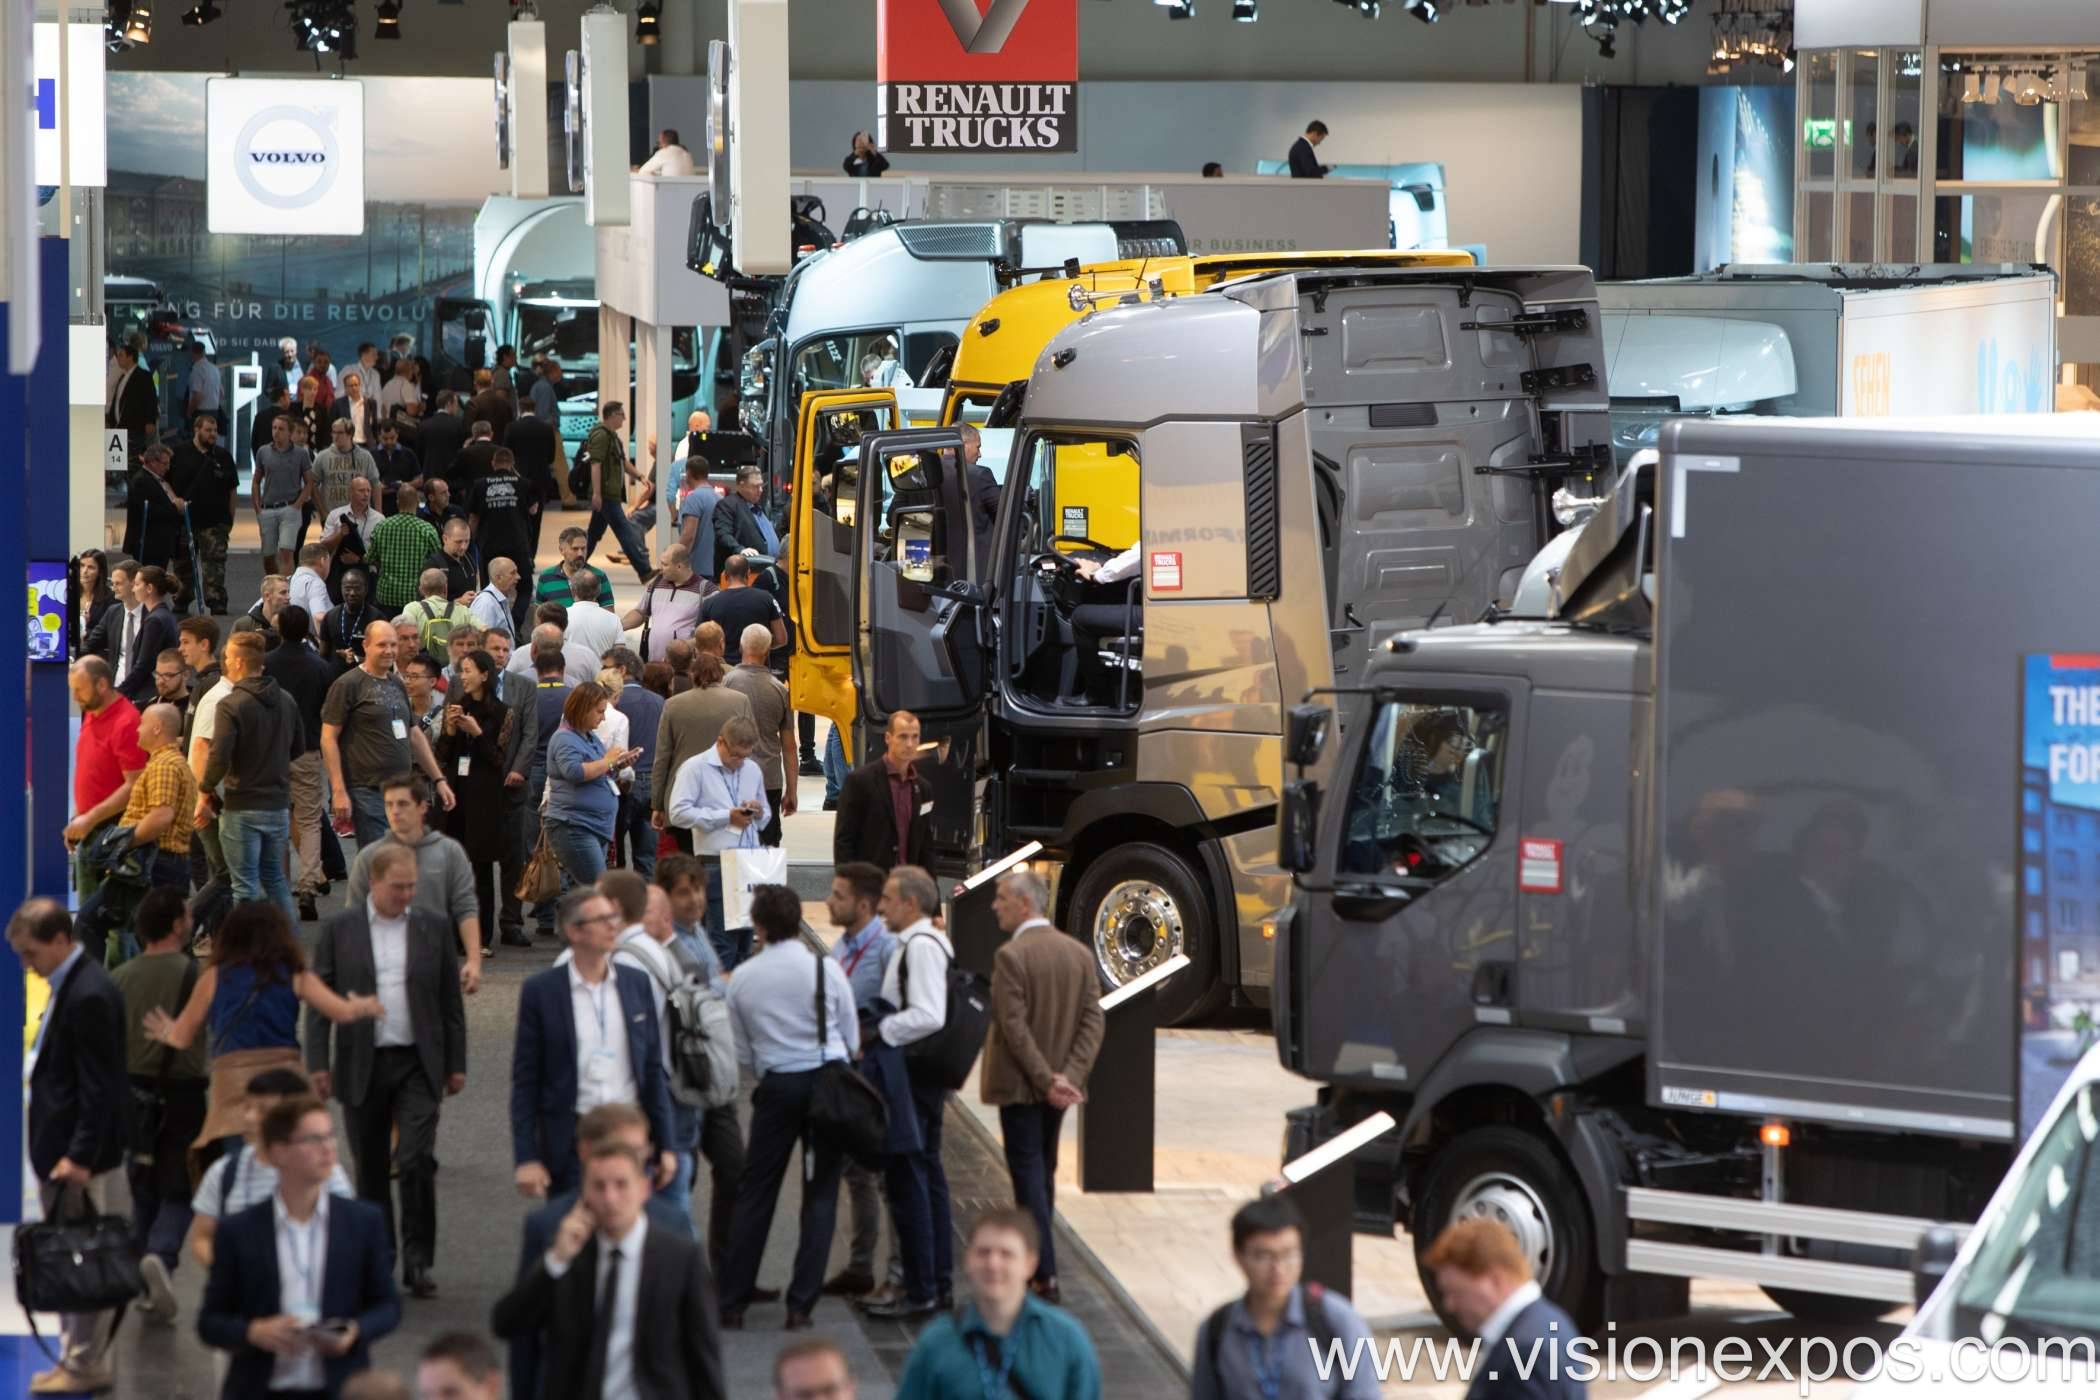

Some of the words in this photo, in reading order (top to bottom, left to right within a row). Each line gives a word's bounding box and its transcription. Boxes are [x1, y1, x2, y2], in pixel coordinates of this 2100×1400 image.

[895, 84, 1071, 115] RENAULT
[905, 117, 1060, 148] TRUCKS
[249, 152, 325, 164] VOLVO
[1210, 239, 1297, 250] BUSINESS
[214, 299, 261, 320] FÜR
[274, 303, 314, 321] DIE
[328, 303, 426, 321] REVOLU
[231, 335, 248, 347] SIE
[109, 434, 123, 451] A
[112, 455, 121, 463] 14
